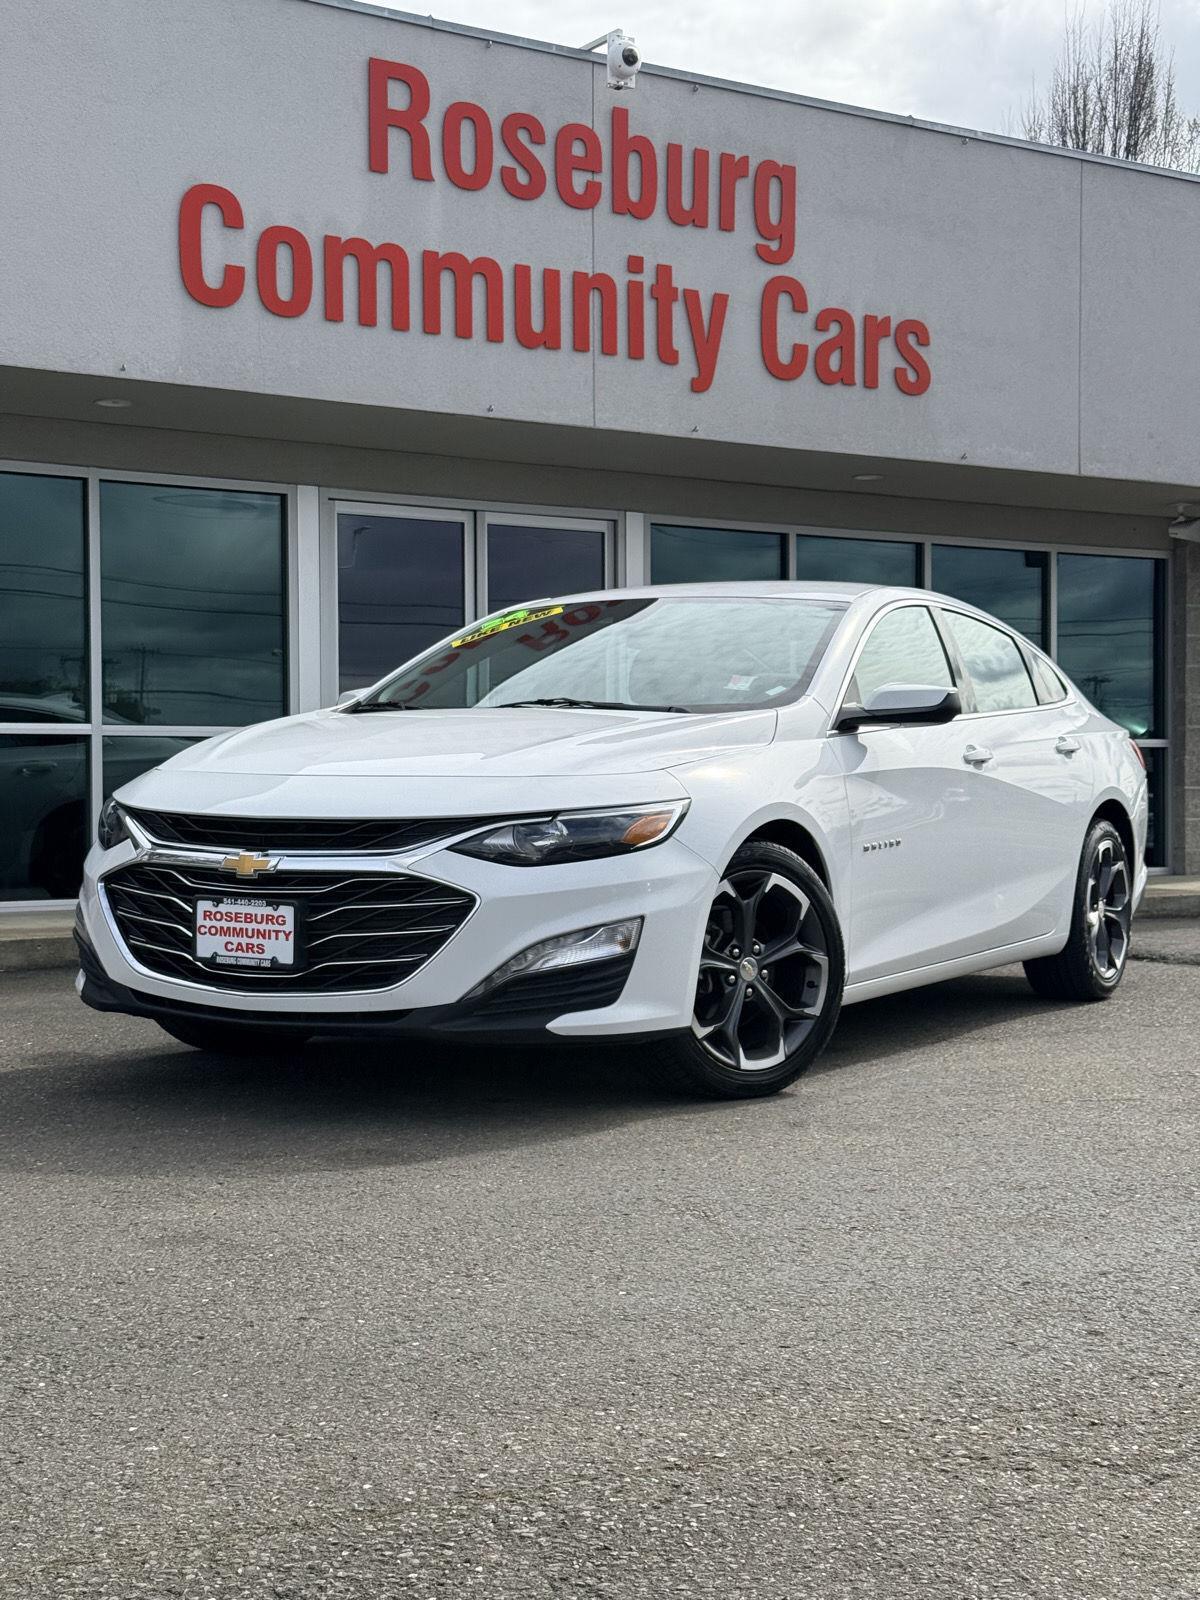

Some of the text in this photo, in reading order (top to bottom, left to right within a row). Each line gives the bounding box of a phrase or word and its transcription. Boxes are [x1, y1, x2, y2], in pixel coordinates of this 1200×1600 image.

[370, 58, 795, 264] Roseburg
[180, 184, 930, 394] Community Cars
[508, 610, 552, 627] NEW
[223, 898, 267, 907] 541-440-2203
[203, 910, 286, 925] ROSEBURG
[197, 925, 292, 941] COMMUNITY
[224, 941, 265, 954] CARS
